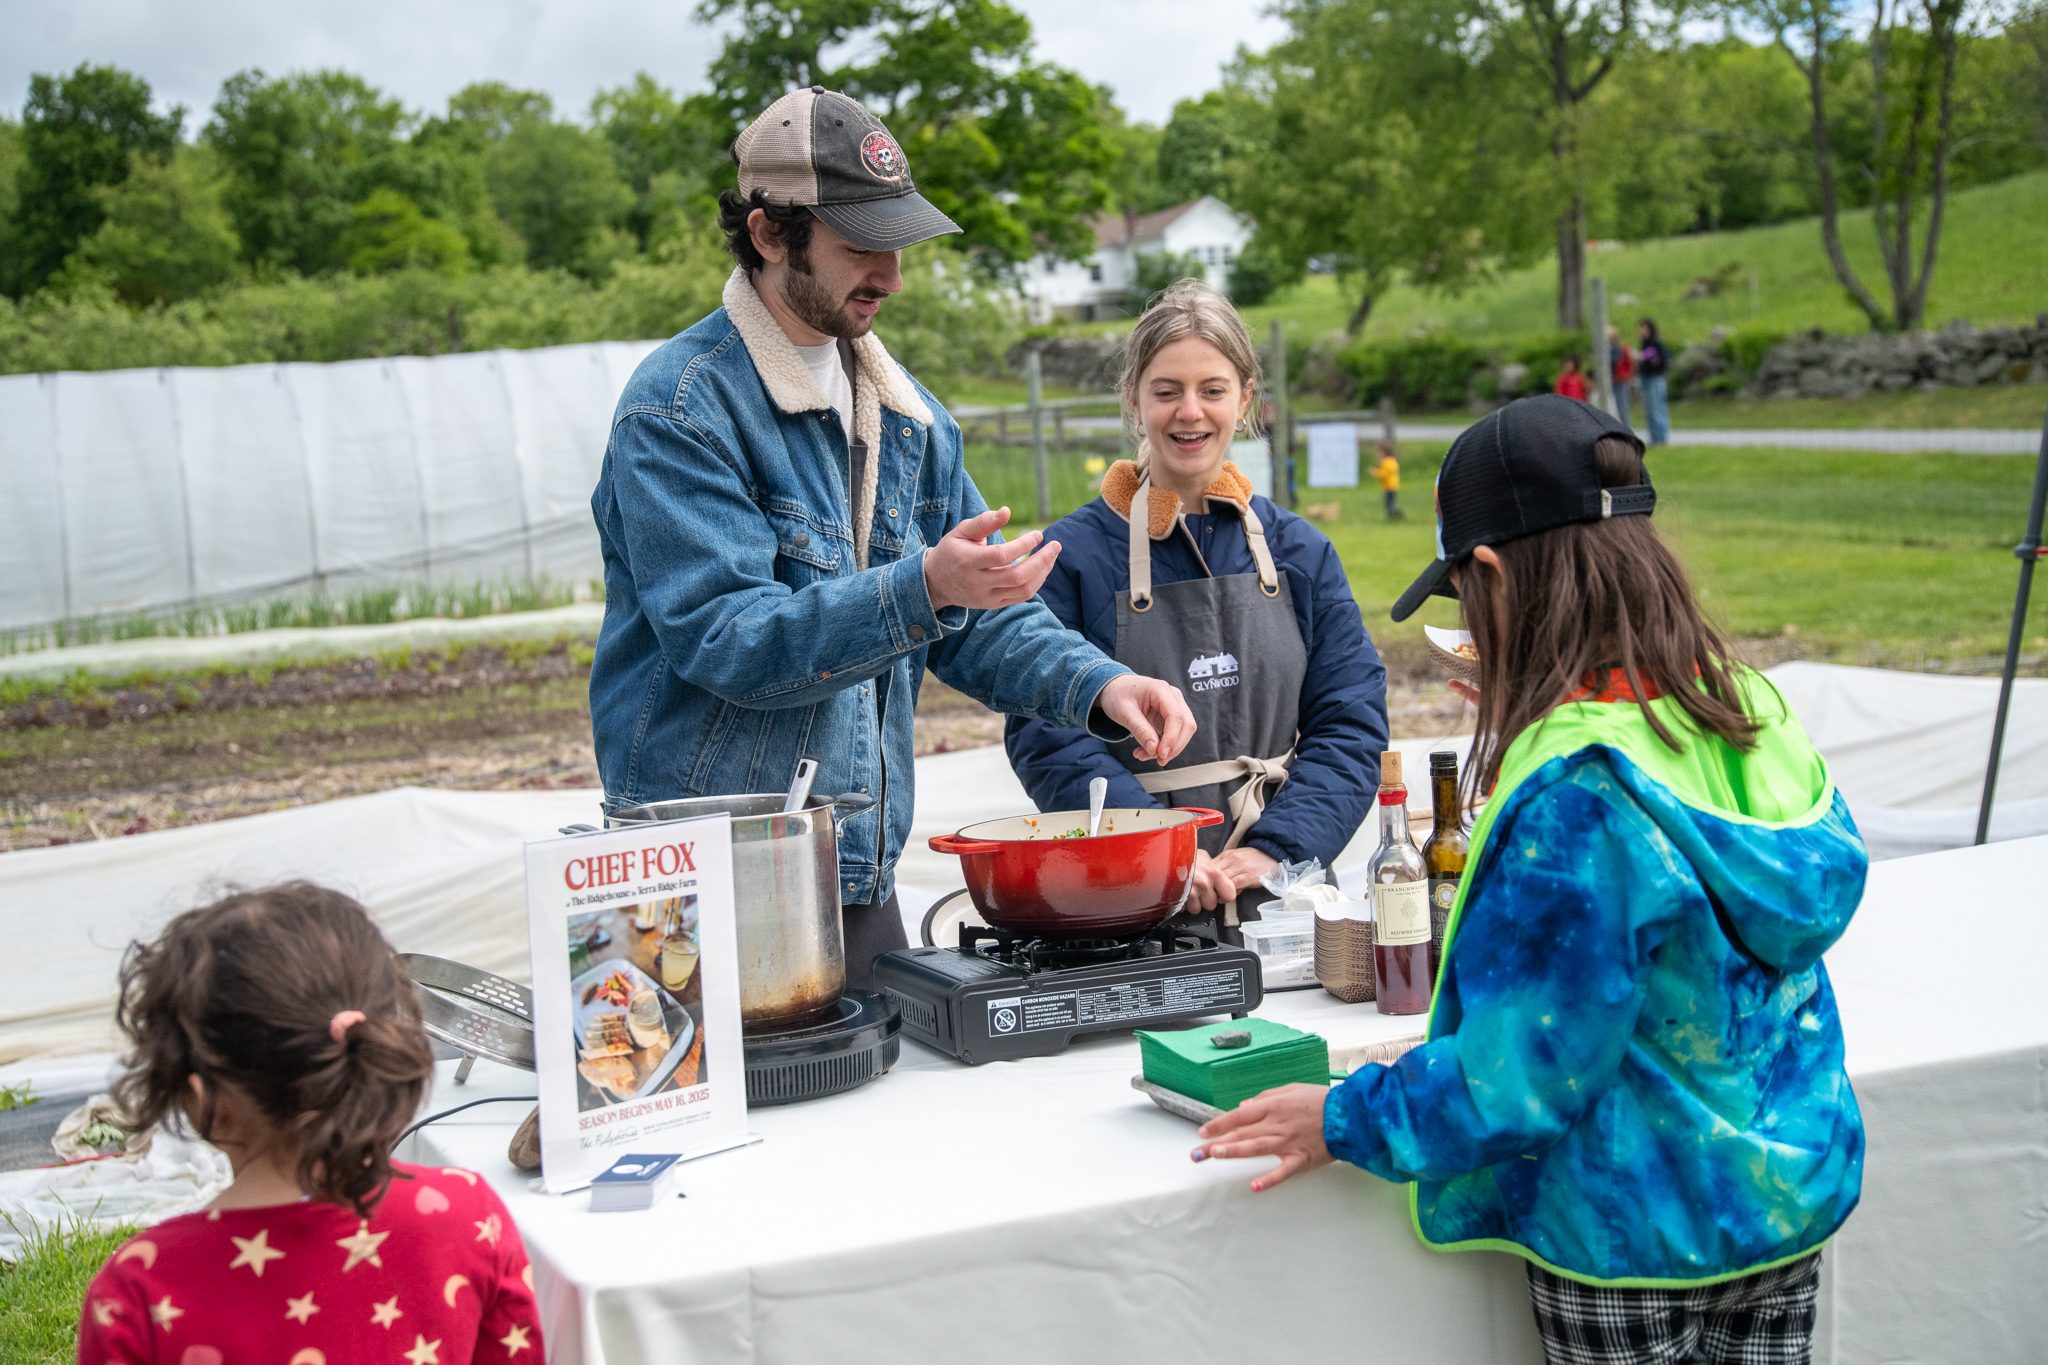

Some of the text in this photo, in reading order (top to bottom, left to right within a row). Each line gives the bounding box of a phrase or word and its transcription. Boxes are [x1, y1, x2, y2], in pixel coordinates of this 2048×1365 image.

[565, 841, 697, 890] CHEF FOX
[637, 885, 657, 895] Terra
[657, 880, 678, 892] Ridge
[679, 879, 698, 888] Farm
[571, 896, 585, 906] The
[999, 999, 1019, 1007] DANGER
[1039, 995, 1059, 1003] MONOXIDE
[579, 1088, 710, 1130] SEASON BEGINS MAY 16, 2025
